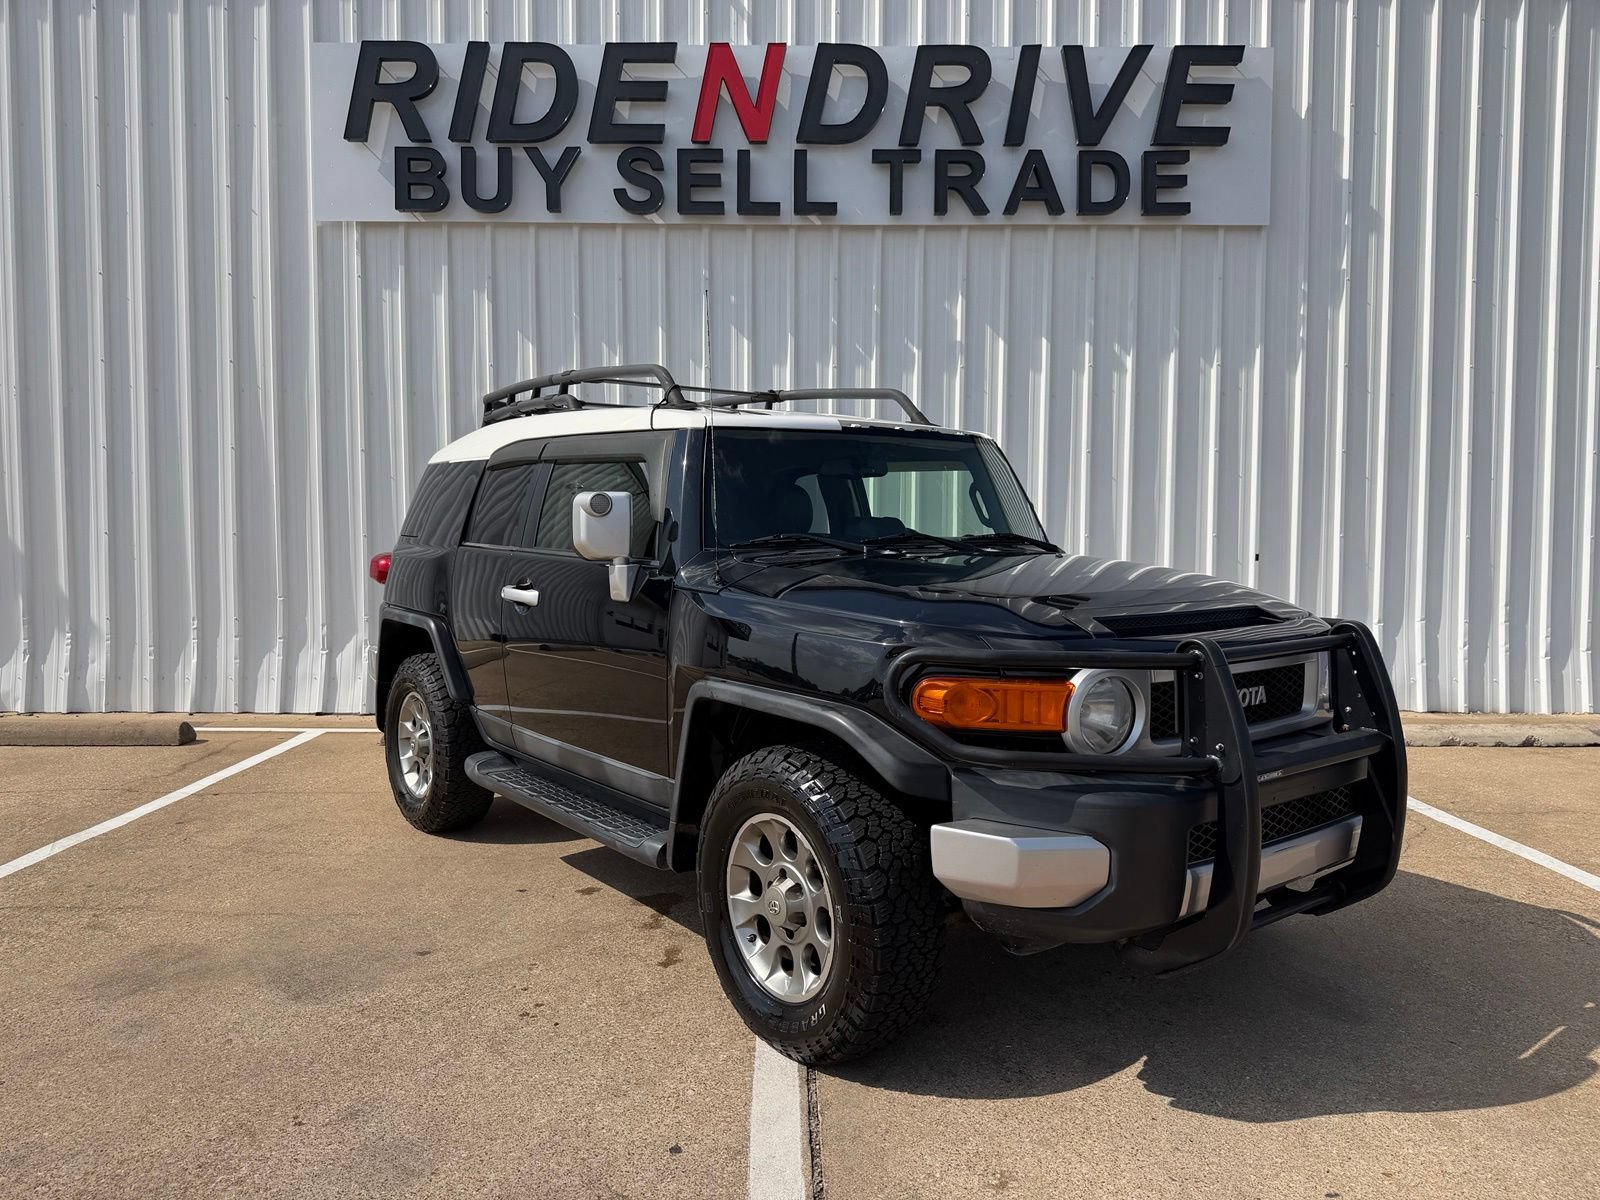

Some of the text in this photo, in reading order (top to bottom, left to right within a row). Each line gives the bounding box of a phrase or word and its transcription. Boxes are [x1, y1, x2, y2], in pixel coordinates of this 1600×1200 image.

[394, 146, 1191, 217] BUY SELL TRADE
[1237, 686, 1267, 708] OTA
